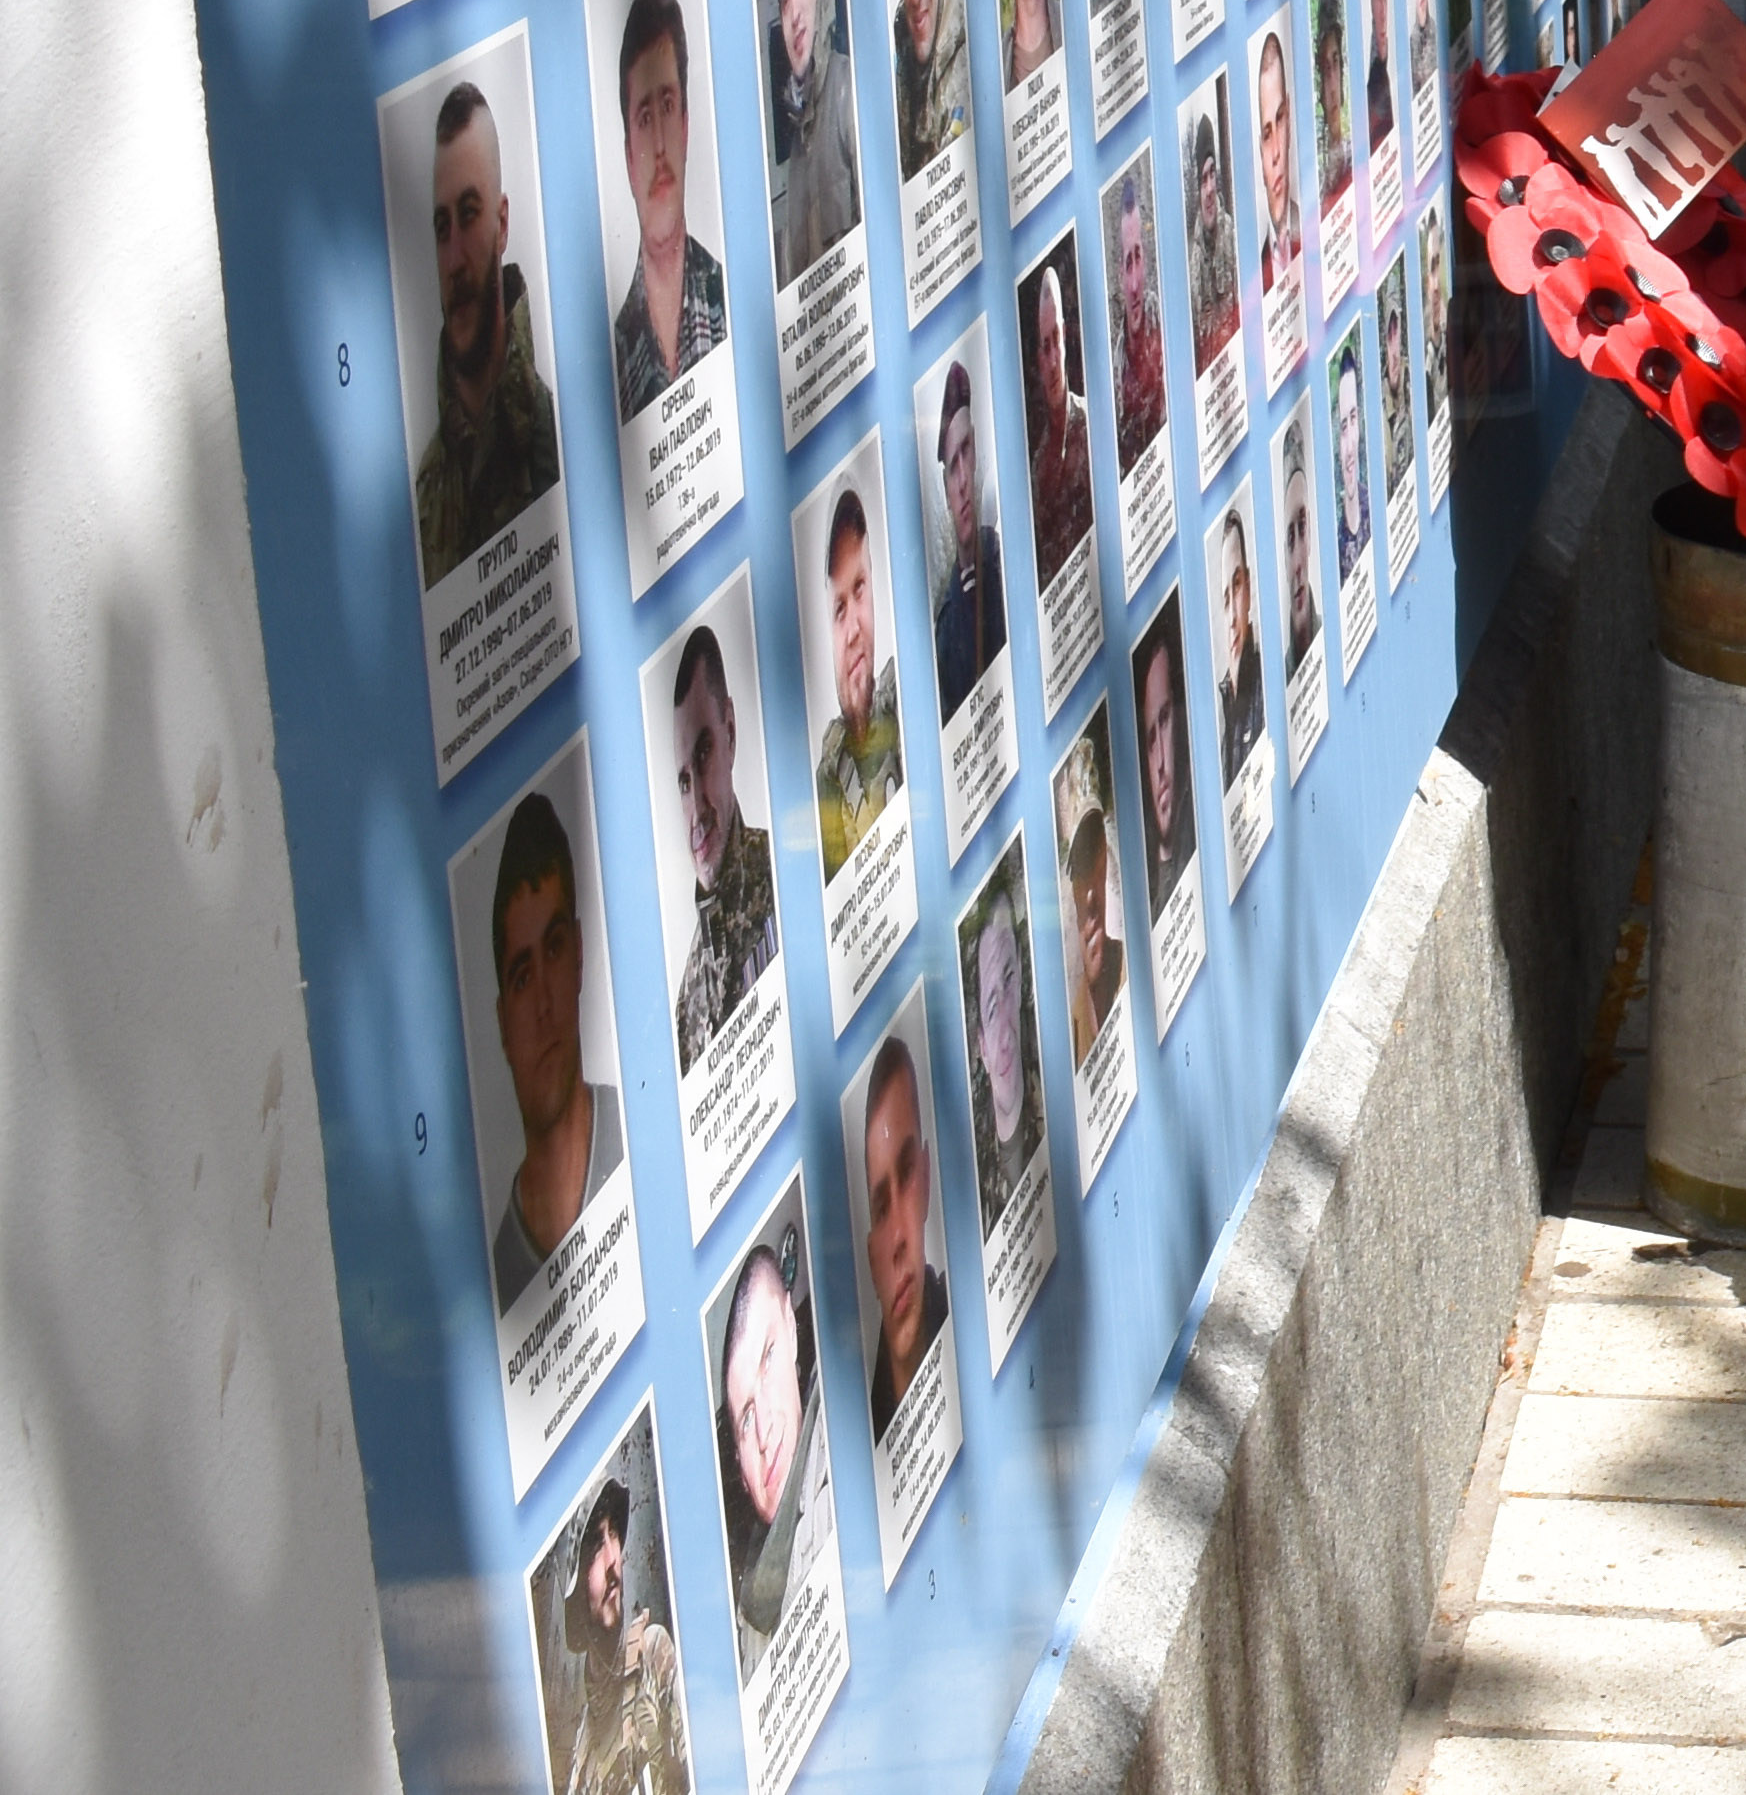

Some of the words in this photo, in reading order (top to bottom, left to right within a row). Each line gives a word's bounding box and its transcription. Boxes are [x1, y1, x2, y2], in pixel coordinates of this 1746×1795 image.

[337, 342, 351, 387] 8
[661, 377, 696, 424] СІРЕНКО
[648, 435, 670, 473] ІВАН
[669, 396, 713, 455] ПАВЛОВИЧ
[439, 599, 485, 666] ДМИТРО
[484, 531, 561, 619] МИКОЛАЙОВИЧ
[476, 529, 518, 584] ПРУГЛО
[455, 672, 491, 719] Окремий
[510, 615, 557, 670] спеціального
[830, 892, 857, 948] ДМИТРО
[856, 820, 908, 906] ОЛЕКСАНДРОВИЧ
[688, 1060, 735, 1137] ОЛЕКСАНДР
[735, 995, 782, 1076] ЛЕОНІДОВИЧ
[707, 985, 760, 1078] КОЛОДЯЖНИЙ
[415, 1111, 428, 1156] 9
[507, 1286, 569, 1387] ВОЛОДИМИР
[569, 1203, 630, 1303] БОГДАНОВИЧ
[547, 1223, 588, 1290] САЛІТРА
[543, 1369, 591, 1443] механізована
[590, 1330, 618, 1376] бригада
[573, 1325, 600, 1370] окрема
[928, 1567, 936, 1601] 3
[758, 1662, 788, 1737] ДМИТРО
[788, 1583, 830, 1680] ДМИТРОВИЧ
[769, 1583, 813, 1679] ДАШКОВЕЦЬ
